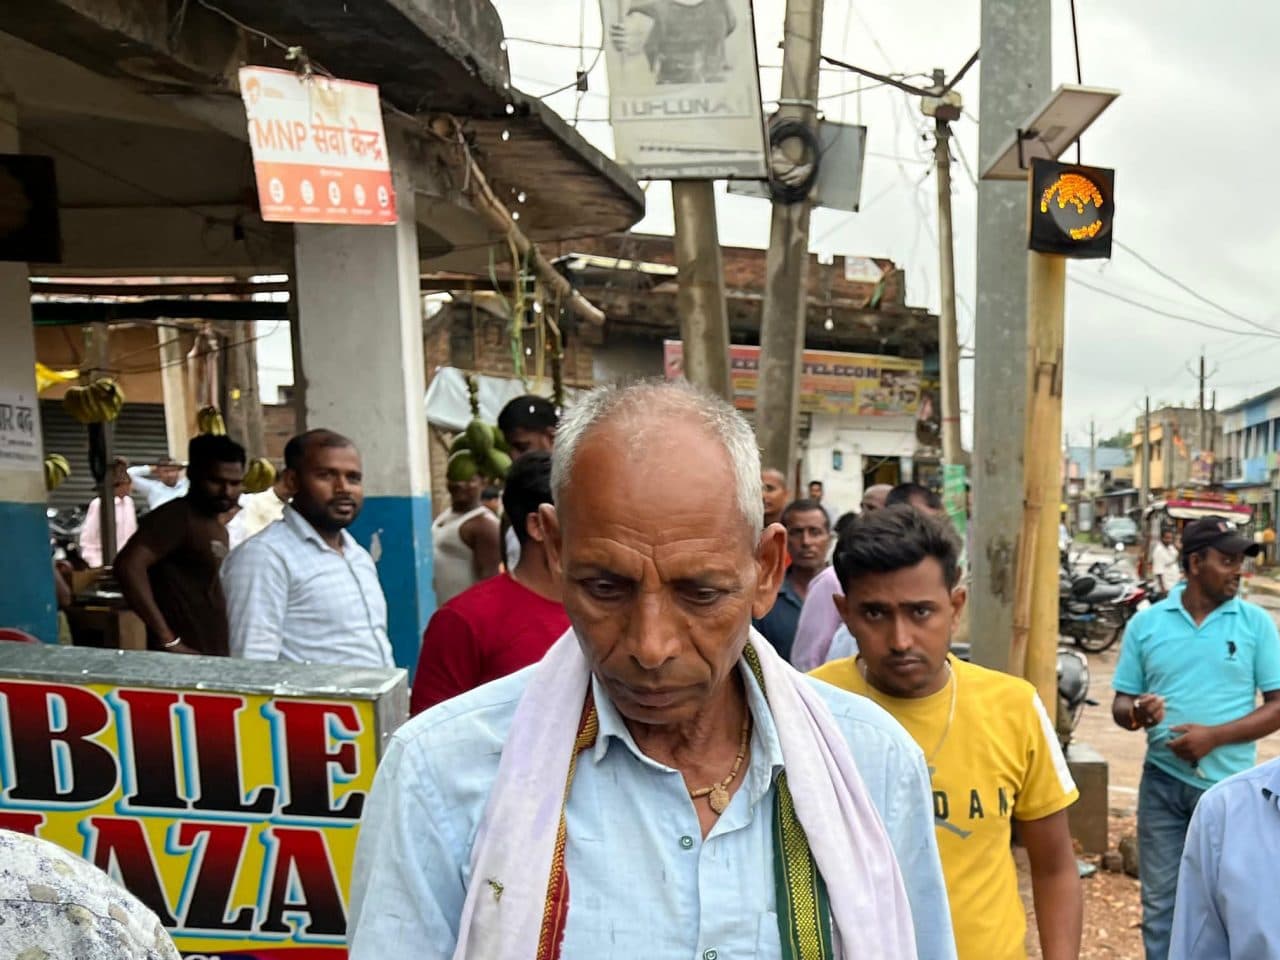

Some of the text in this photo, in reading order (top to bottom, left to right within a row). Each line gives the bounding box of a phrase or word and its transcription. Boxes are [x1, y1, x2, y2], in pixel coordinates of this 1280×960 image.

[252, 118, 307, 151] MNP
[311, 112, 348, 157] सेवा
[802, 363, 878, 379] TELECOM
[0, 810, 348, 938] AZA
